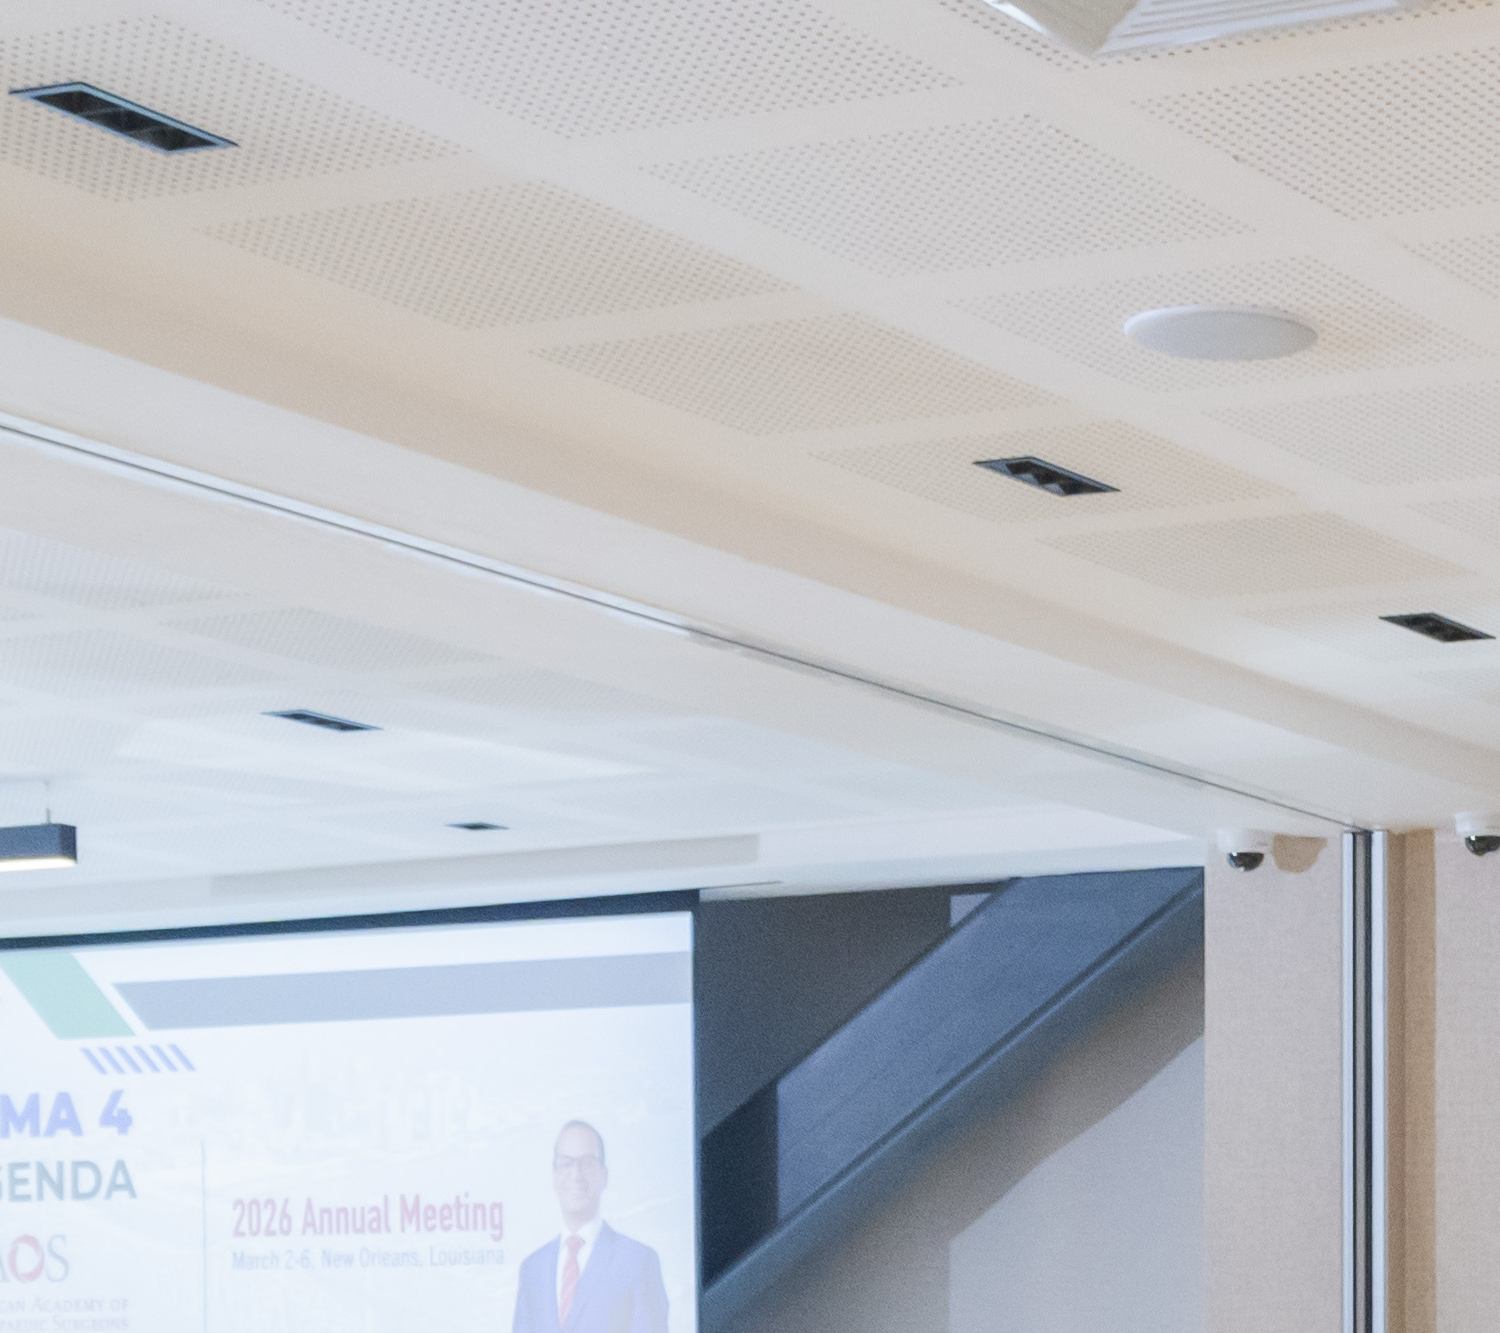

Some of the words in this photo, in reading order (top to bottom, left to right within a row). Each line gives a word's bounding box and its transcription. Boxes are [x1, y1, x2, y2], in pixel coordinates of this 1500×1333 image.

[99, 1089, 133, 1136] 4
[232, 1197, 293, 1238] 2026
[301, 1194, 391, 1236] Annual
[399, 1191, 504, 1242] Meeting
[232, 1250, 280, 1271] March
[321, 1248, 355, 1269] New
[359, 1247, 424, 1269] Orleans,
[429, 1245, 505, 1267] Louisiana
